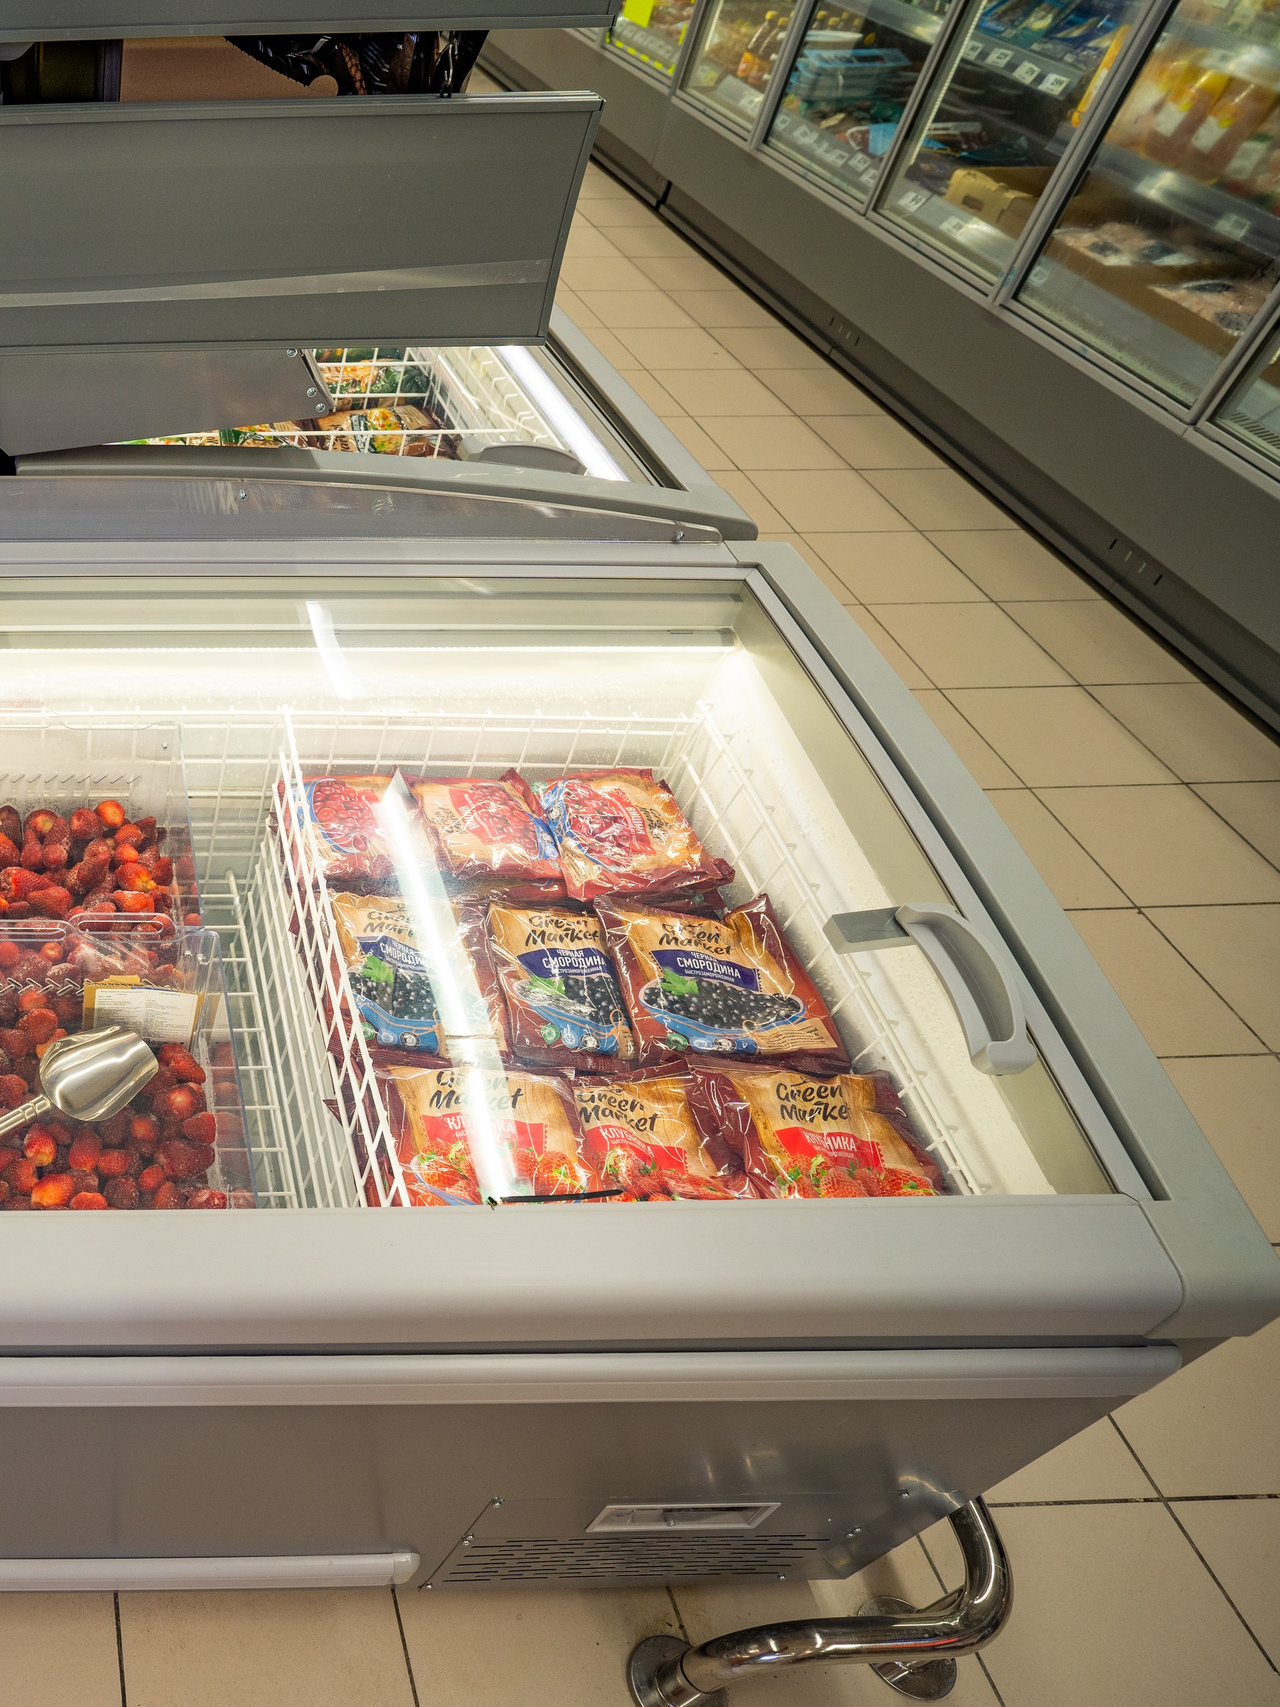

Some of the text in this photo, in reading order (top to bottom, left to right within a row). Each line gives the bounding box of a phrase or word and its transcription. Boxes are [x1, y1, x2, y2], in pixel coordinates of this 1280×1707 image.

[524, 928, 600, 948] Market
[542, 955, 608, 970] СМОРОДИНА
[556, 948, 585, 958] ЧЕРНАЯ
[676, 956, 742, 979] СМОРОДИНА
[429, 1087, 525, 1110] Maket
[775, 1082, 844, 1103] Green
[580, 1103, 661, 1133] Market
[780, 1101, 851, 1124] Marke
